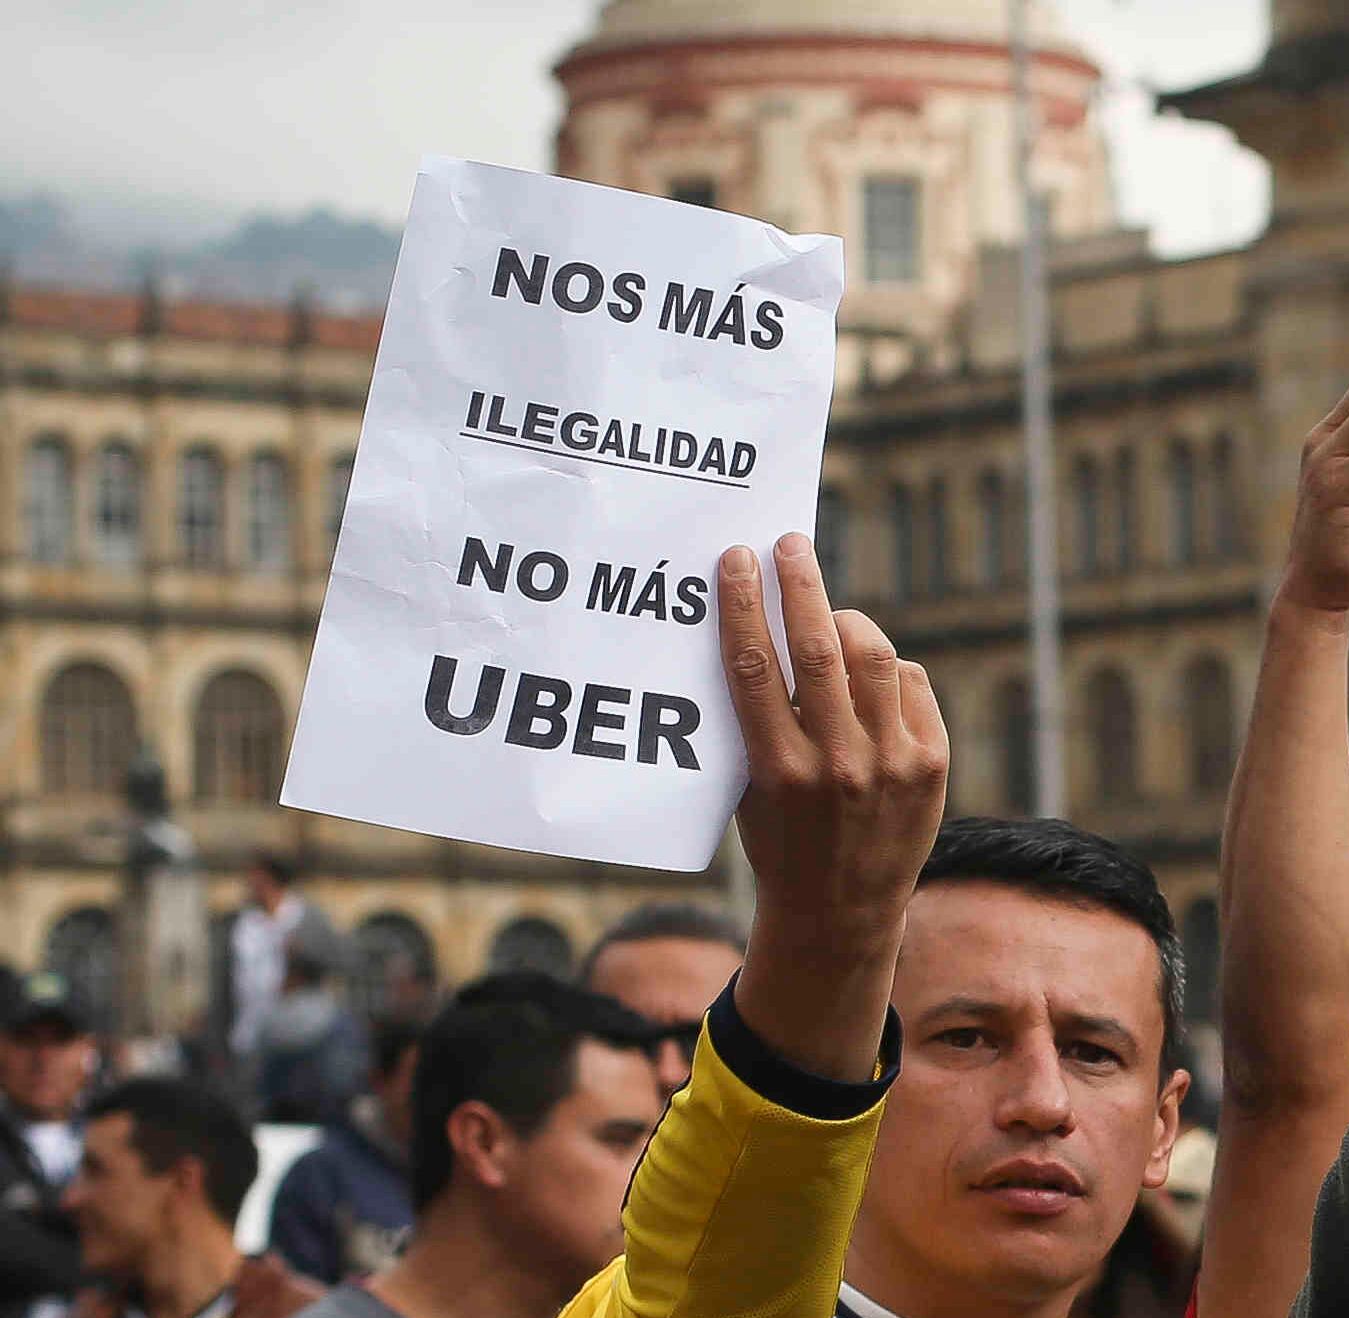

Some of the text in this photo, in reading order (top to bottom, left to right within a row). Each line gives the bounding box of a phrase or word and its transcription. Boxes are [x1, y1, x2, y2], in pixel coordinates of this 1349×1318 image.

[490, 247, 784, 351] NOS MÁS
[465, 390, 757, 479] ILEGALIDAD
[456, 536, 709, 626] NO MÁS
[424, 654, 702, 772] UBER
